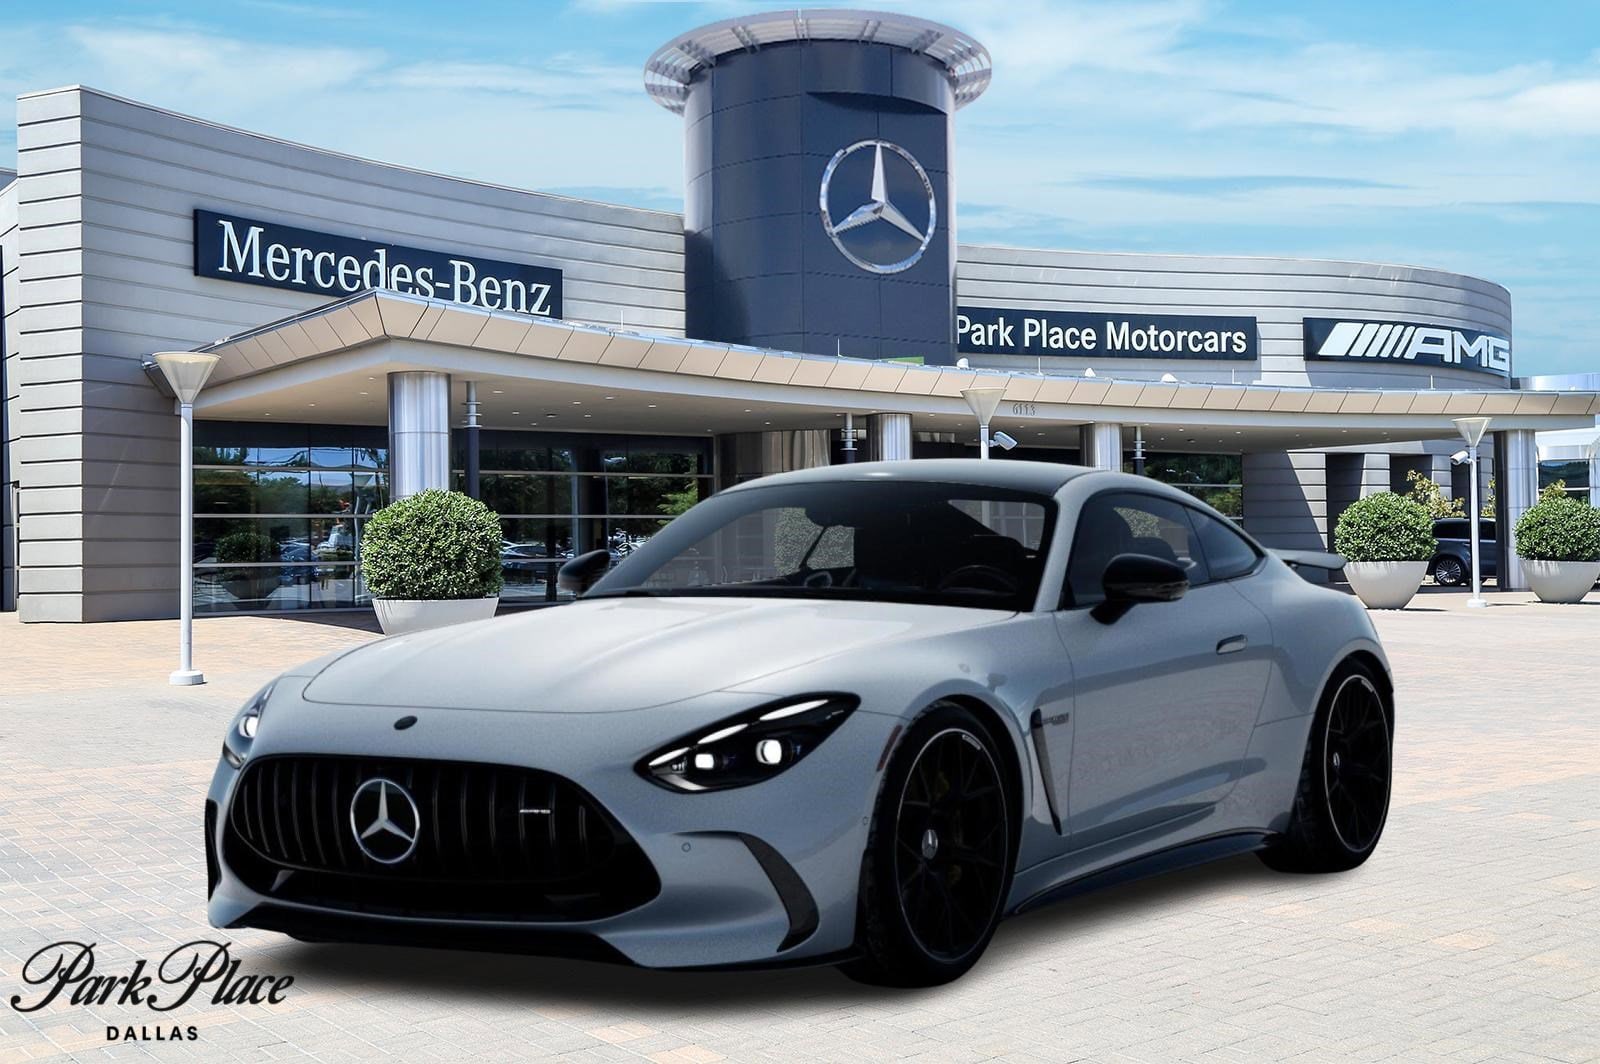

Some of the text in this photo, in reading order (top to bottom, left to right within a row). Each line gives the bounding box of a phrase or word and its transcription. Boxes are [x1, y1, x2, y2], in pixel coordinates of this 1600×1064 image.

[217, 220, 552, 316] Mercedes-Benz
[957, 315, 1248, 354] Park Place Motorcars
[1403, 326, 1510, 372] AMG
[1012, 402, 1036, 416] 6113
